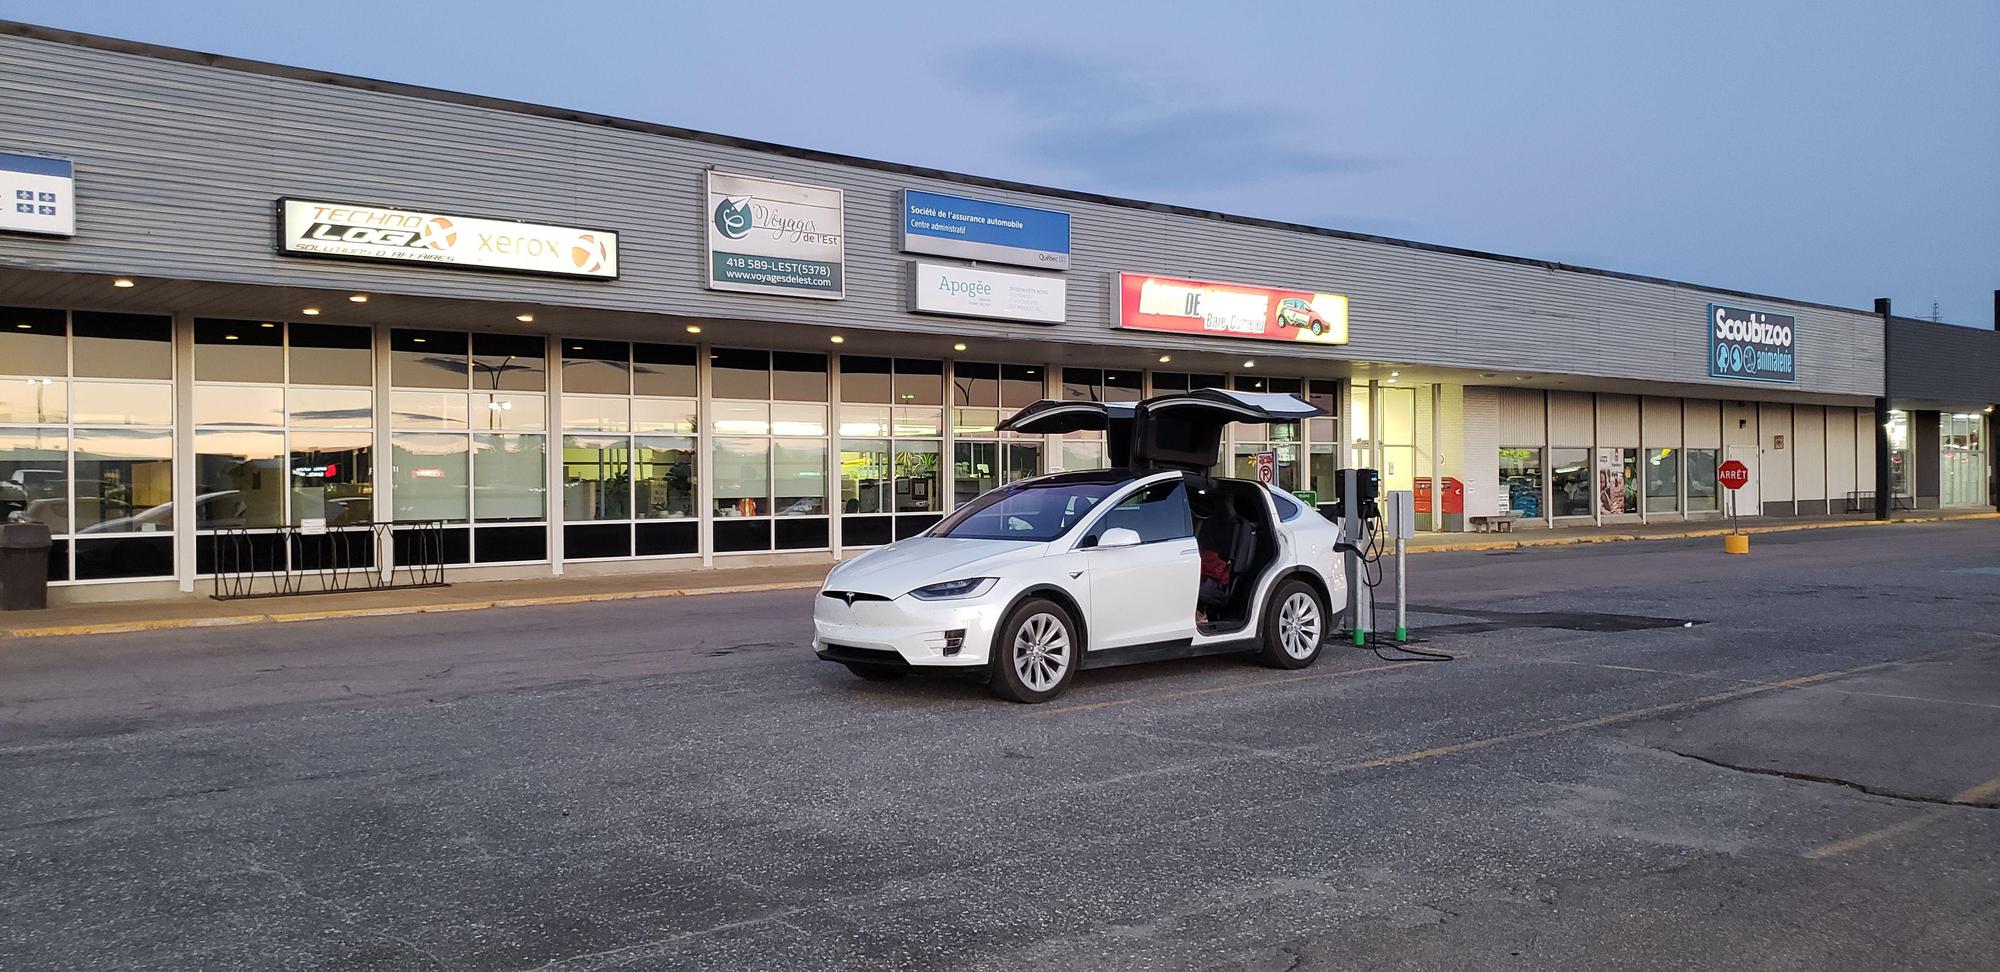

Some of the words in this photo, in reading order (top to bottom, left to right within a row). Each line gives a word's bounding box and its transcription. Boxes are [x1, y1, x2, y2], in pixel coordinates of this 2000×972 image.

[313, 206, 423, 228] TECHNO
[753, 204, 817, 243] Voyages
[910, 205, 937, 217] Société
[938, 210, 947, 219] de
[948, 211, 986, 225] l'assurance
[987, 218, 1024, 230] automobile
[911, 219, 930, 230] Centre
[931, 222, 967, 235] administratif
[478, 233, 560, 259] xerox
[803, 232, 815, 243] de
[726, 258, 745, 268] 418
[748, 259, 831, 277] 589-LEST(5378)
[726, 270, 832, 286] www.voyagesdelest.com
[938, 275, 992, 298] Apogée
[1184, 292, 1201, 316] DE
[1716, 308, 1791, 347] Scoubizoo
[1720, 469, 1747, 480] ARRÊT
